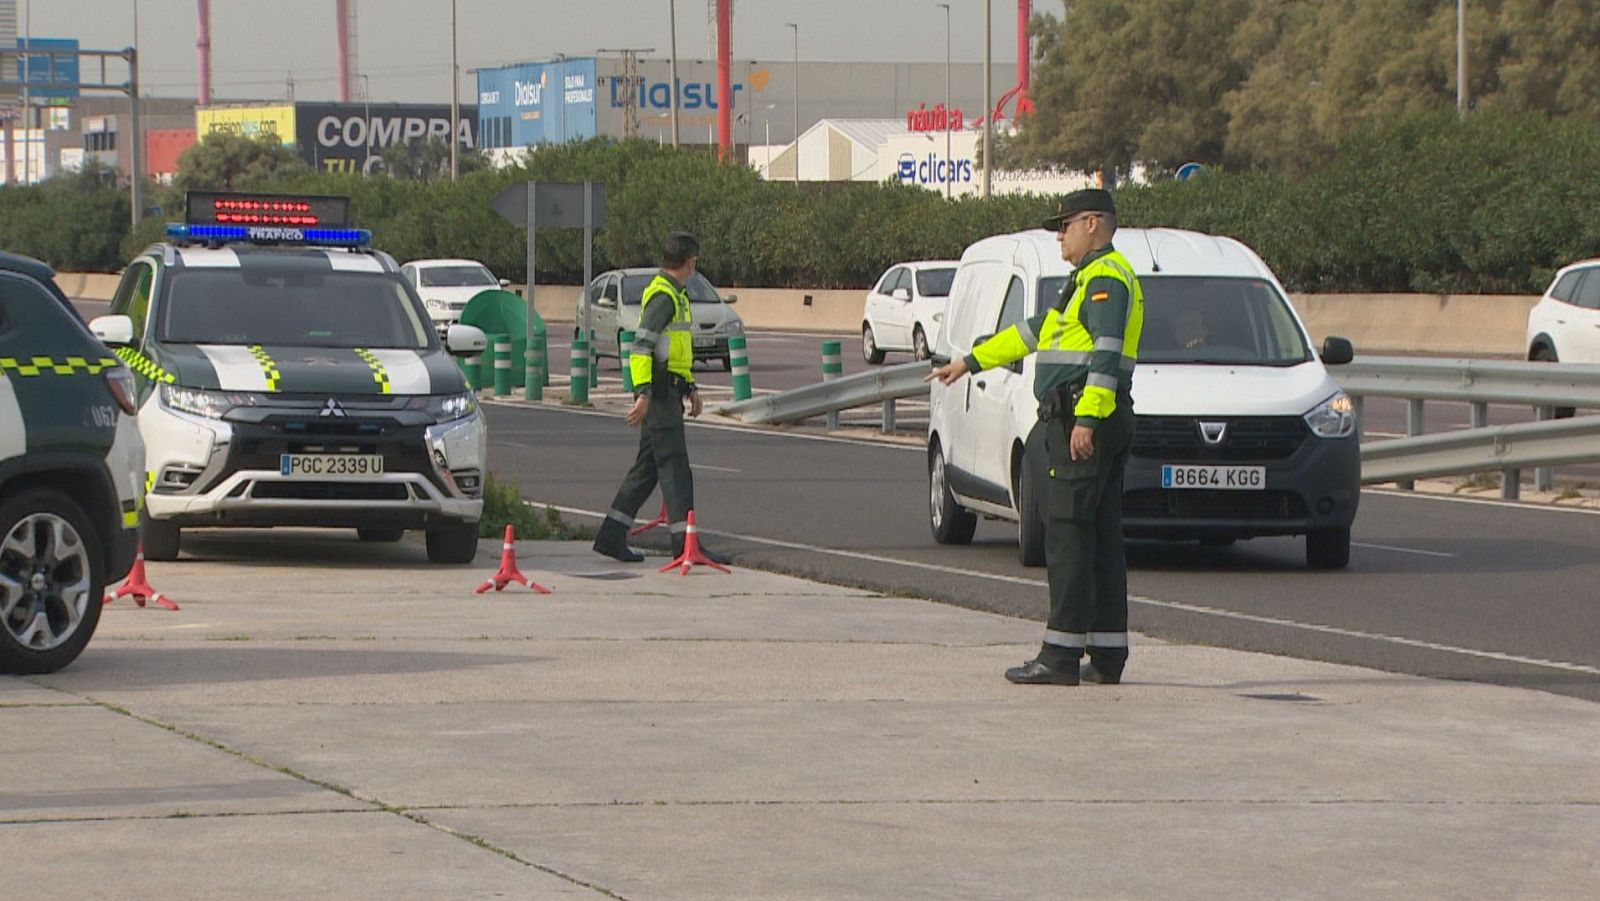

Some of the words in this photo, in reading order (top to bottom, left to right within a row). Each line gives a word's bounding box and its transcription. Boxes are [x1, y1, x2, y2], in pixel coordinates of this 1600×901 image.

[514, 80, 541, 107] Dialsur
[317, 115, 479, 148] COMPRA
[919, 152, 971, 184] clicars
[291, 457, 322, 473] PGC
[326, 458, 367, 474] 2339
[371, 457, 382, 474] U
[1175, 468, 1219, 486] 8664
[1226, 469, 1260, 486] KGG
